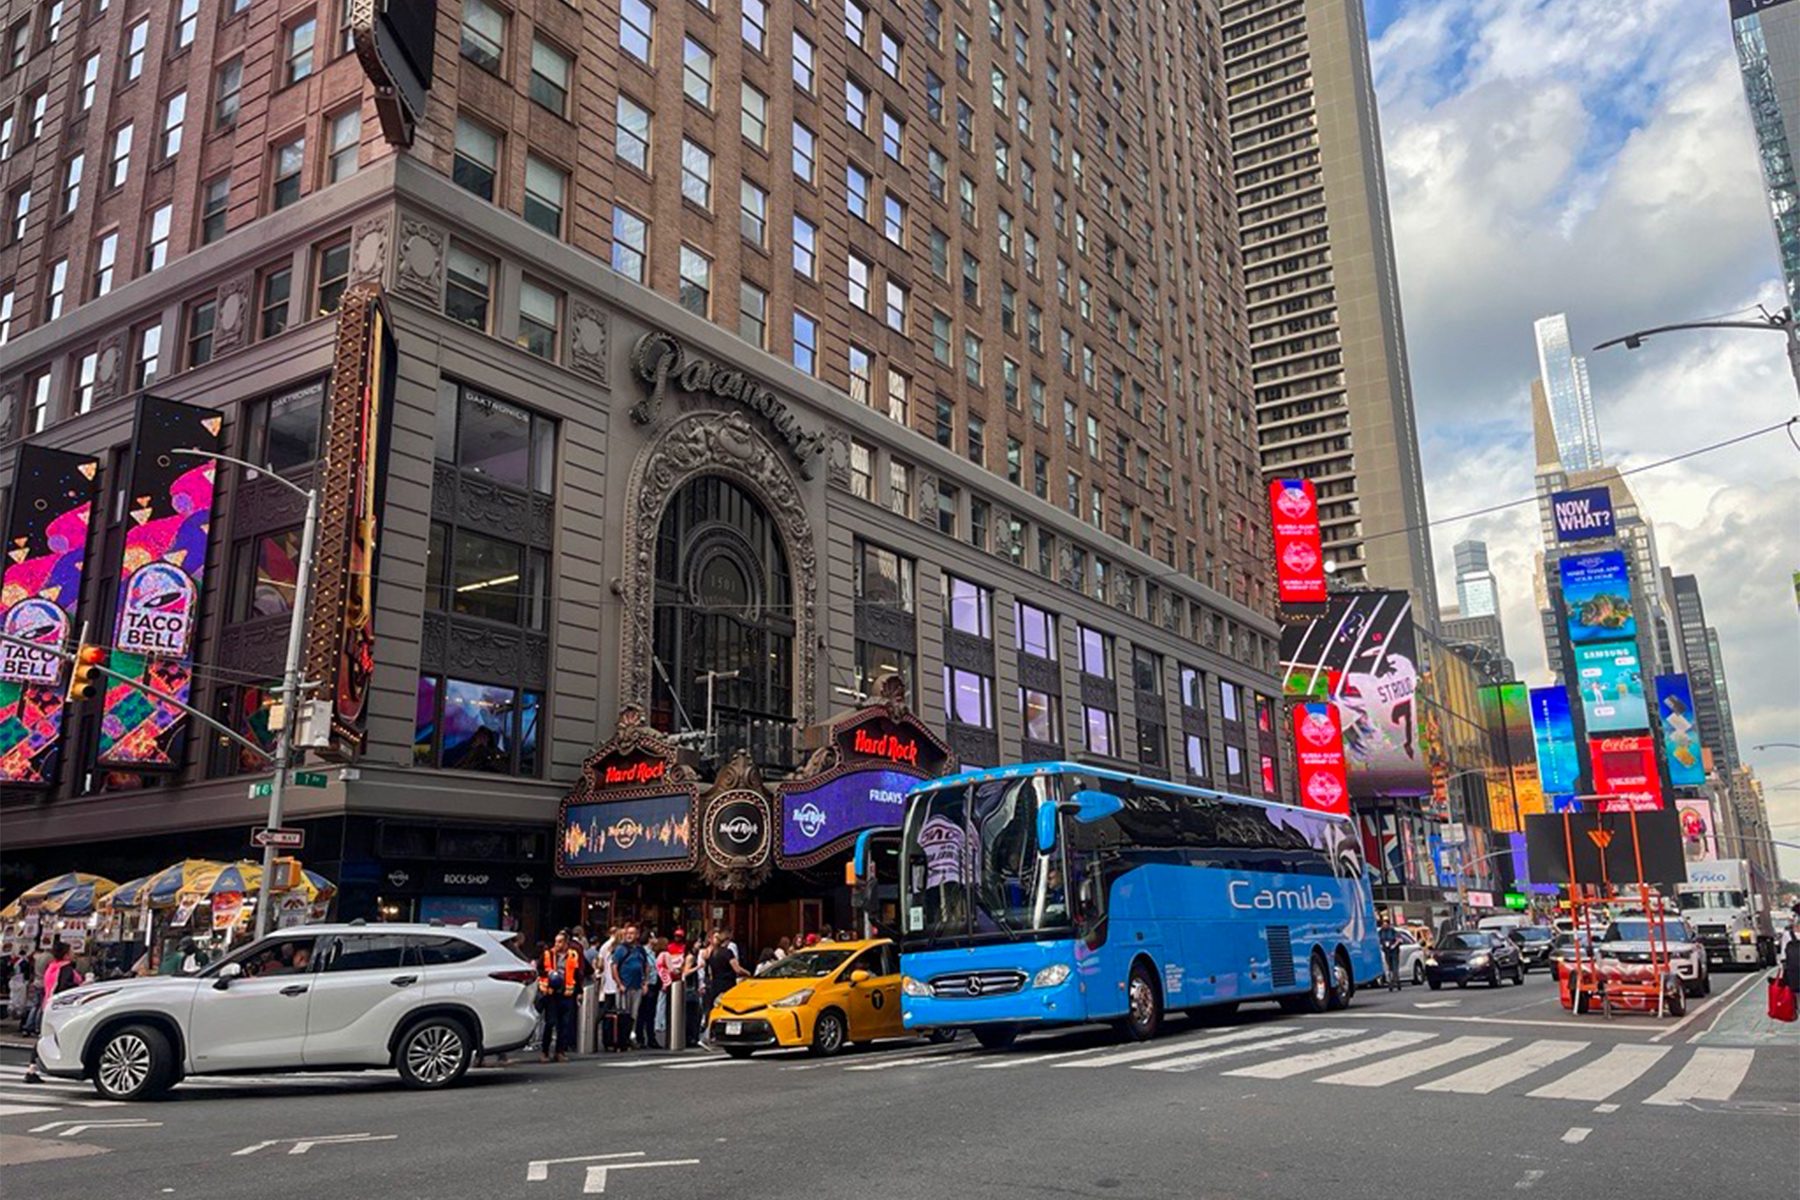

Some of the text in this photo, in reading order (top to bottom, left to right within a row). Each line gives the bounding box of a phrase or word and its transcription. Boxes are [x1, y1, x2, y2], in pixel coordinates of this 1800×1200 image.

[629, 331, 825, 482] Paramount
[1555, 499, 1590, 518] NOW
[1558, 511, 1611, 532] WHAT?
[127, 613, 183, 632] TACO
[127, 630, 178, 649] BELL
[4, 644, 57, 662] TACO
[1584, 648, 1629, 659] SAMSUNG
[4, 660, 51, 677] BELL
[1391, 700, 1414, 761] 7
[854, 729, 918, 768] Hard Rock
[605, 766, 637, 783] Hard
[869, 789, 903, 805] FRIDAYS
[444, 873, 490, 885] ROCK SHOP
[1228, 880, 1333, 911] Camila
